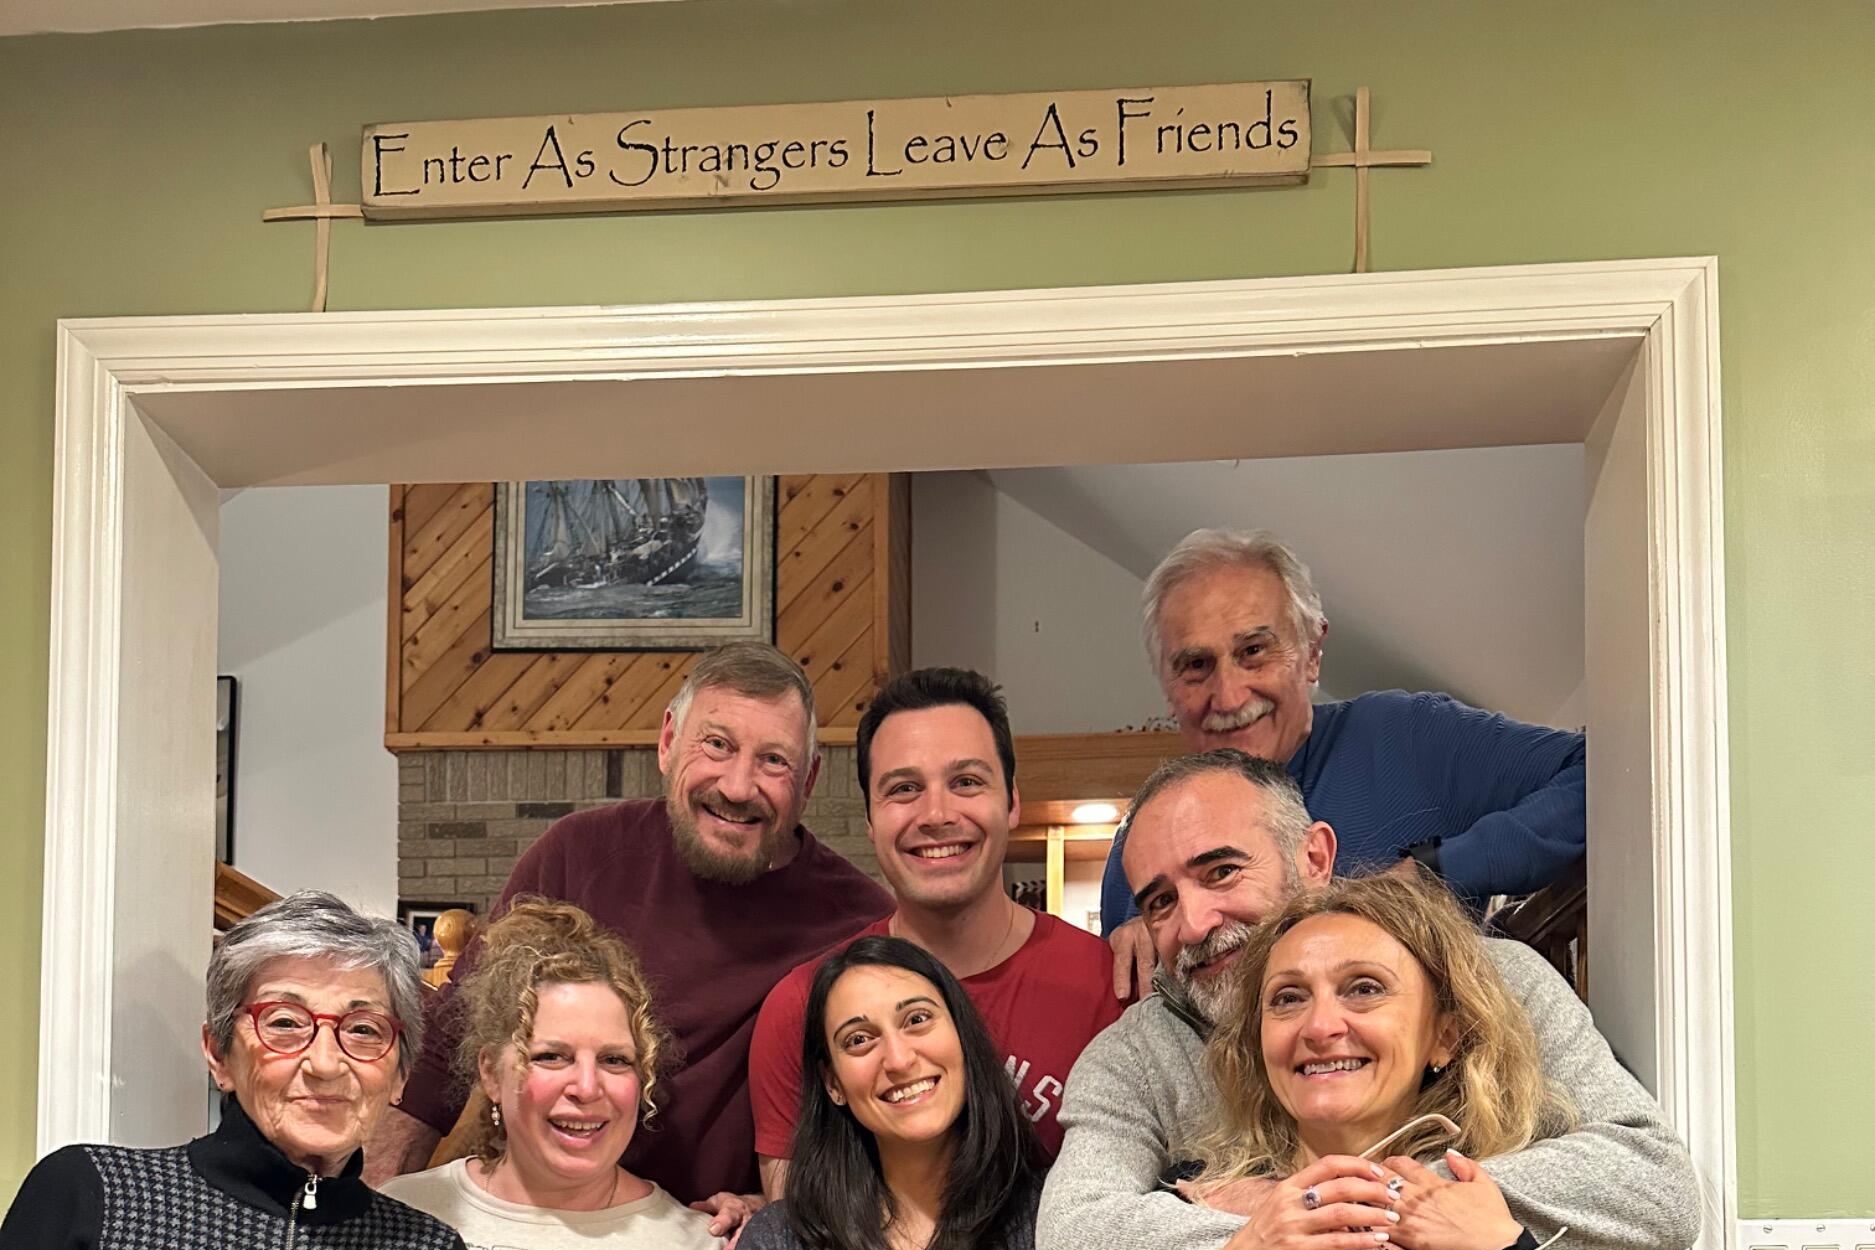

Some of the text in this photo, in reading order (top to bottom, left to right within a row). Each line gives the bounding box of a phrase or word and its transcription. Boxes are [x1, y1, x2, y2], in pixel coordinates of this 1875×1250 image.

[372, 89, 1299, 196] Enter As Strangers Leave As Friends
